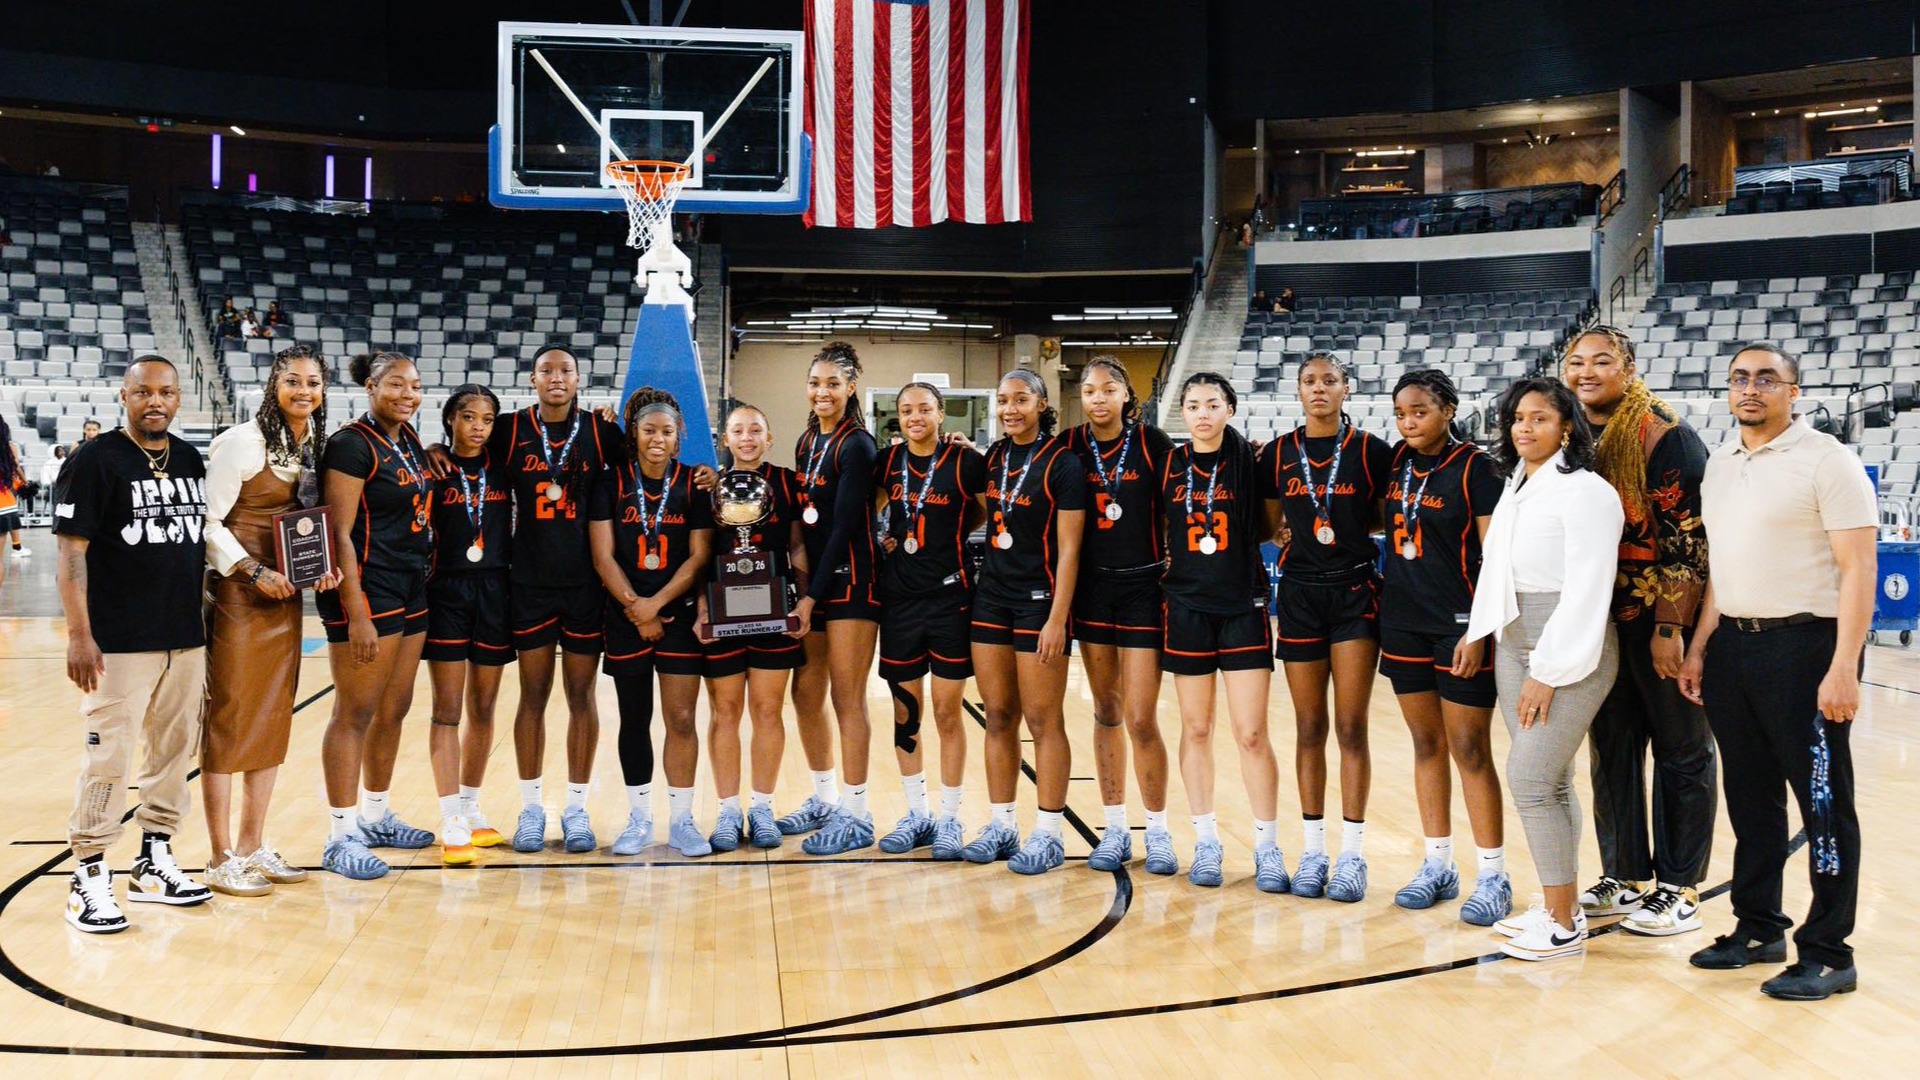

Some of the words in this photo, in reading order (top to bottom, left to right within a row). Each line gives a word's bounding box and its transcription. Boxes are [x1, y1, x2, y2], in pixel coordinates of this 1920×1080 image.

[132, 508, 148, 518] THE
[1095, 492, 1115, 529] 5
[1187, 511, 1228, 551] 23
[726, 563, 737, 573] 20
[755, 561, 766, 570] 26
[717, 628, 740, 636] STATE
[741, 625, 783, 635] RUNNER-UP
